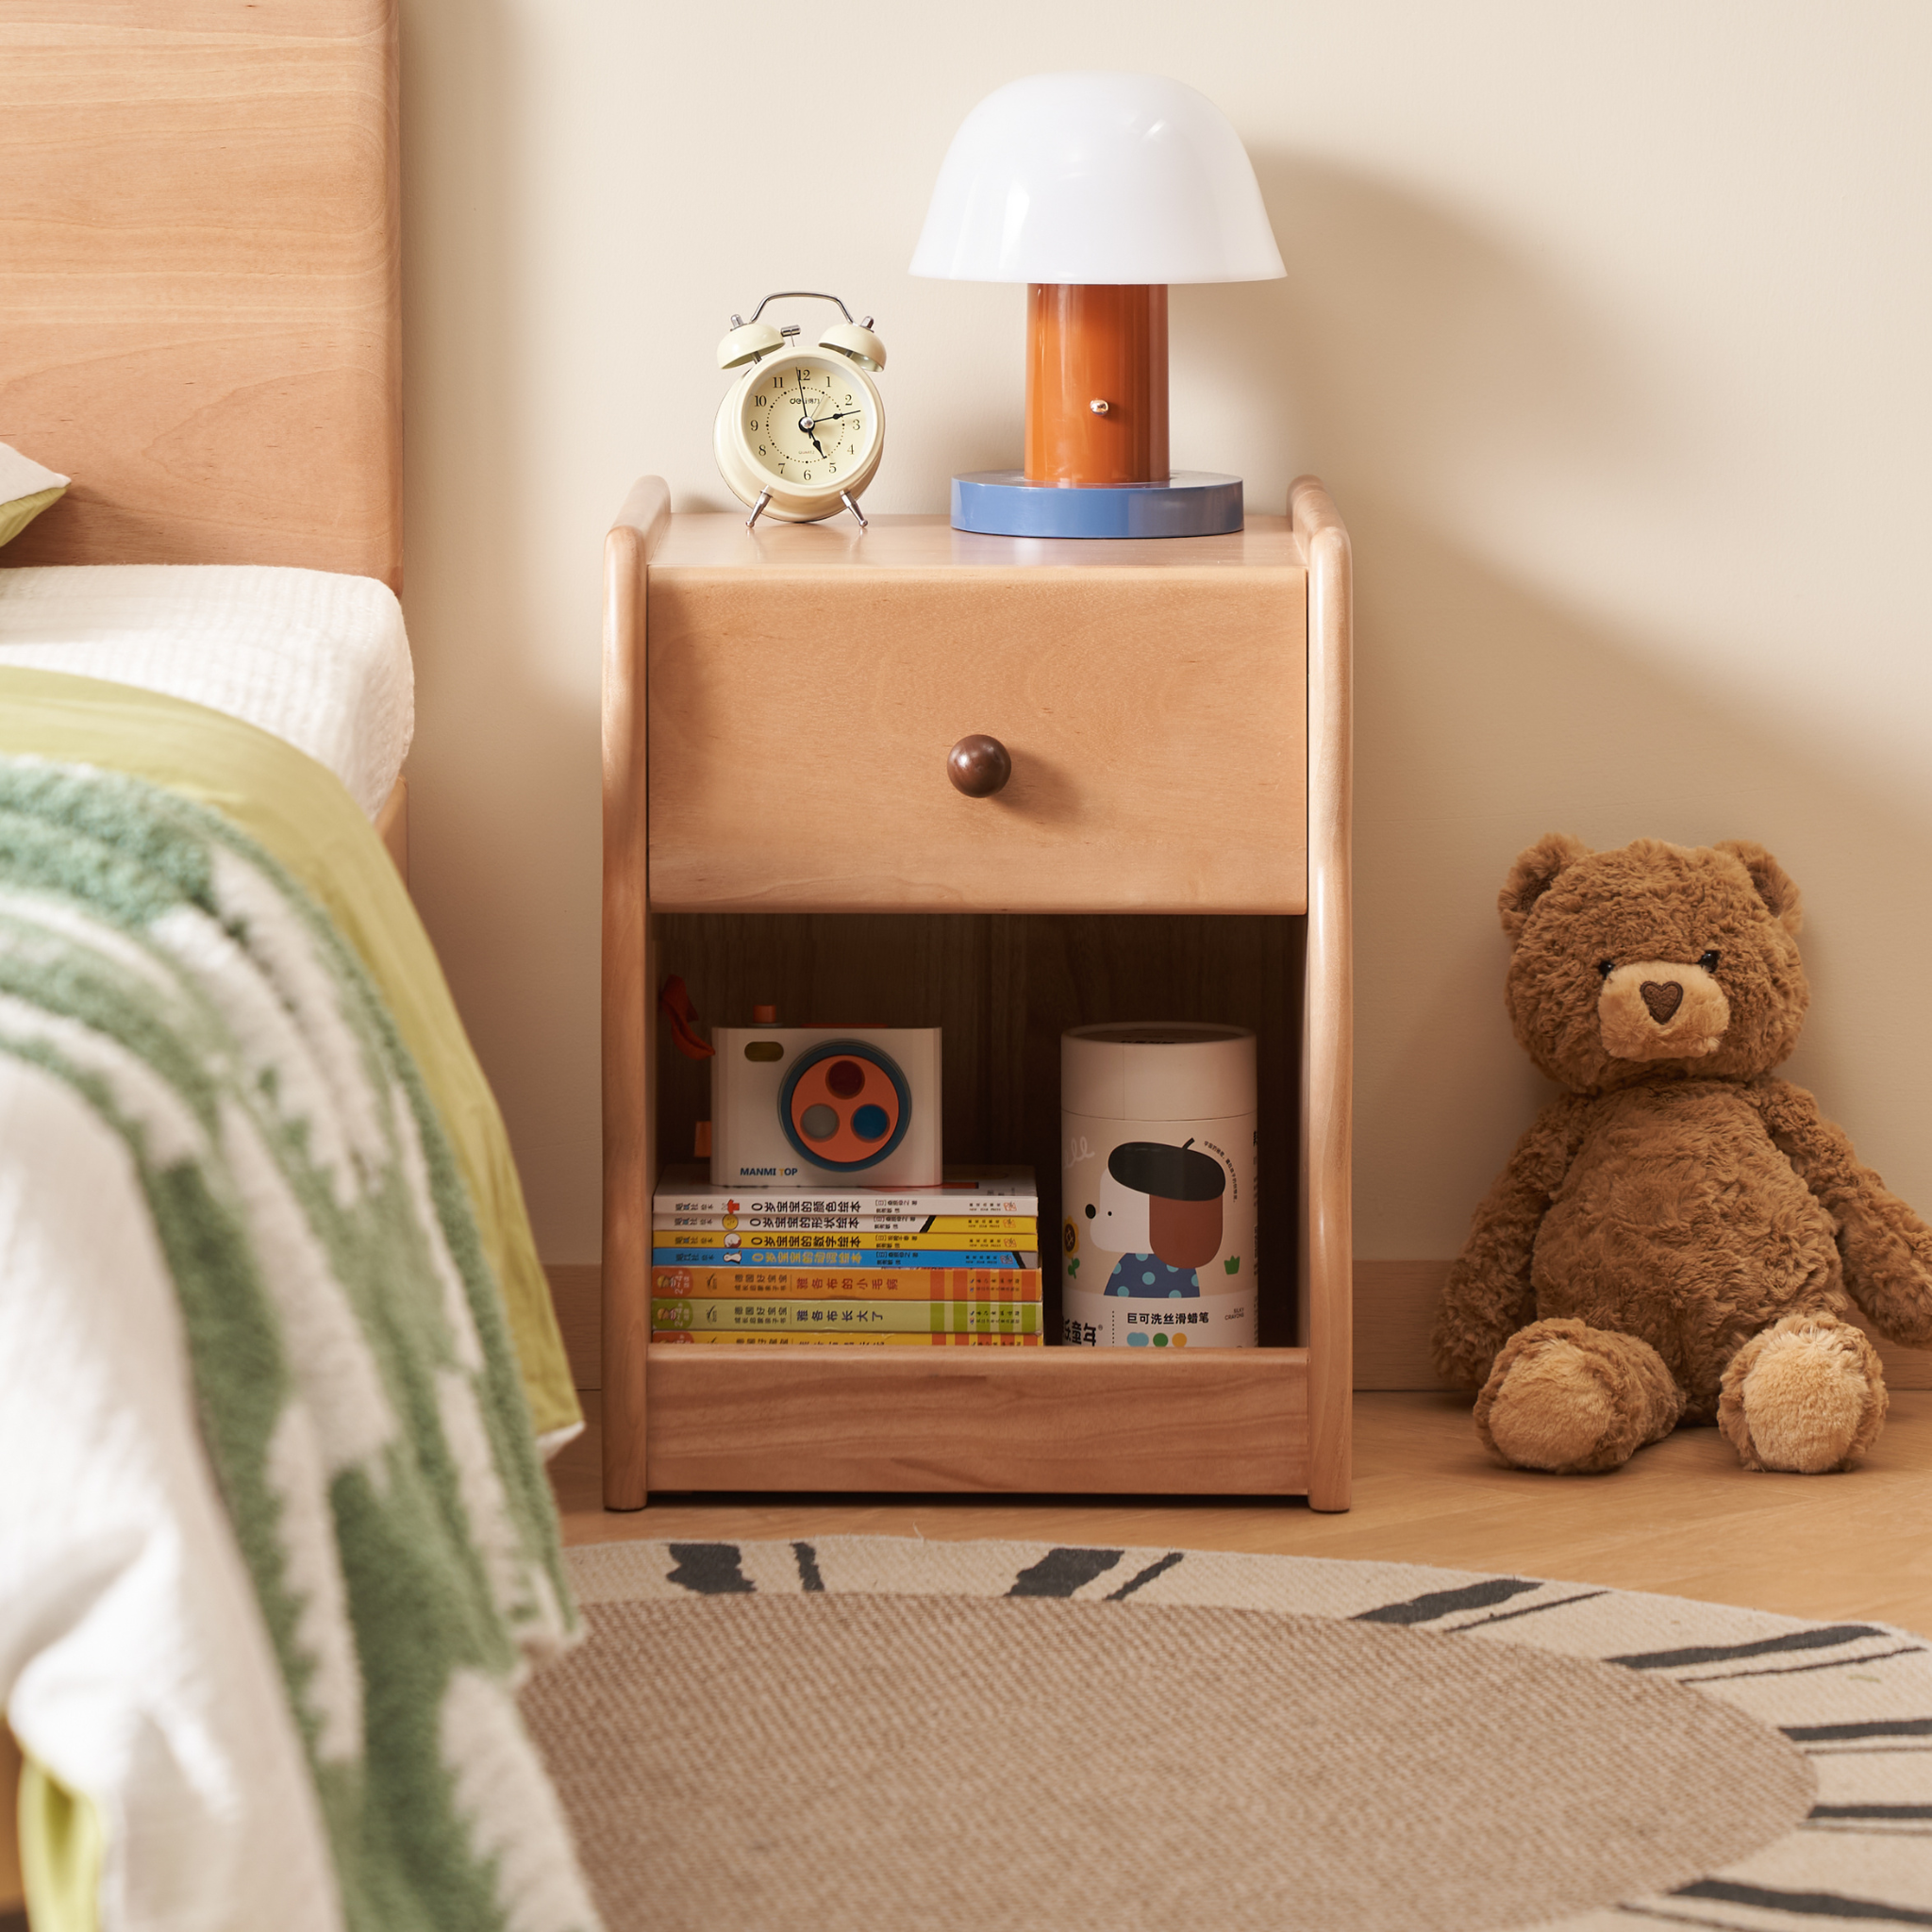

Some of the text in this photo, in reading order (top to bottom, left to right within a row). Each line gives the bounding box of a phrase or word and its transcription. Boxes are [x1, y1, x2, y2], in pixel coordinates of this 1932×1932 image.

[797, 370, 810, 380] 12
[773, 377, 784, 388] 11
[825, 376, 831, 387] 1
[755, 395, 767, 407] 10
[845, 394, 853, 406] 2
[750, 420, 758, 431] 9
[853, 420, 860, 430] 3
[758, 444, 766, 456] 8
[847, 444, 854, 455] 4
[778, 463, 785, 474] 7
[829, 462, 837, 474] 5
[804, 470, 811, 480] 6
[796, 1277, 898, 1290] 雅各布的小毛病
[796, 1310, 883, 1322] 雅各布长大了
[1127, 1312, 1209, 1324] 巨可洗丝滑蜡笔
